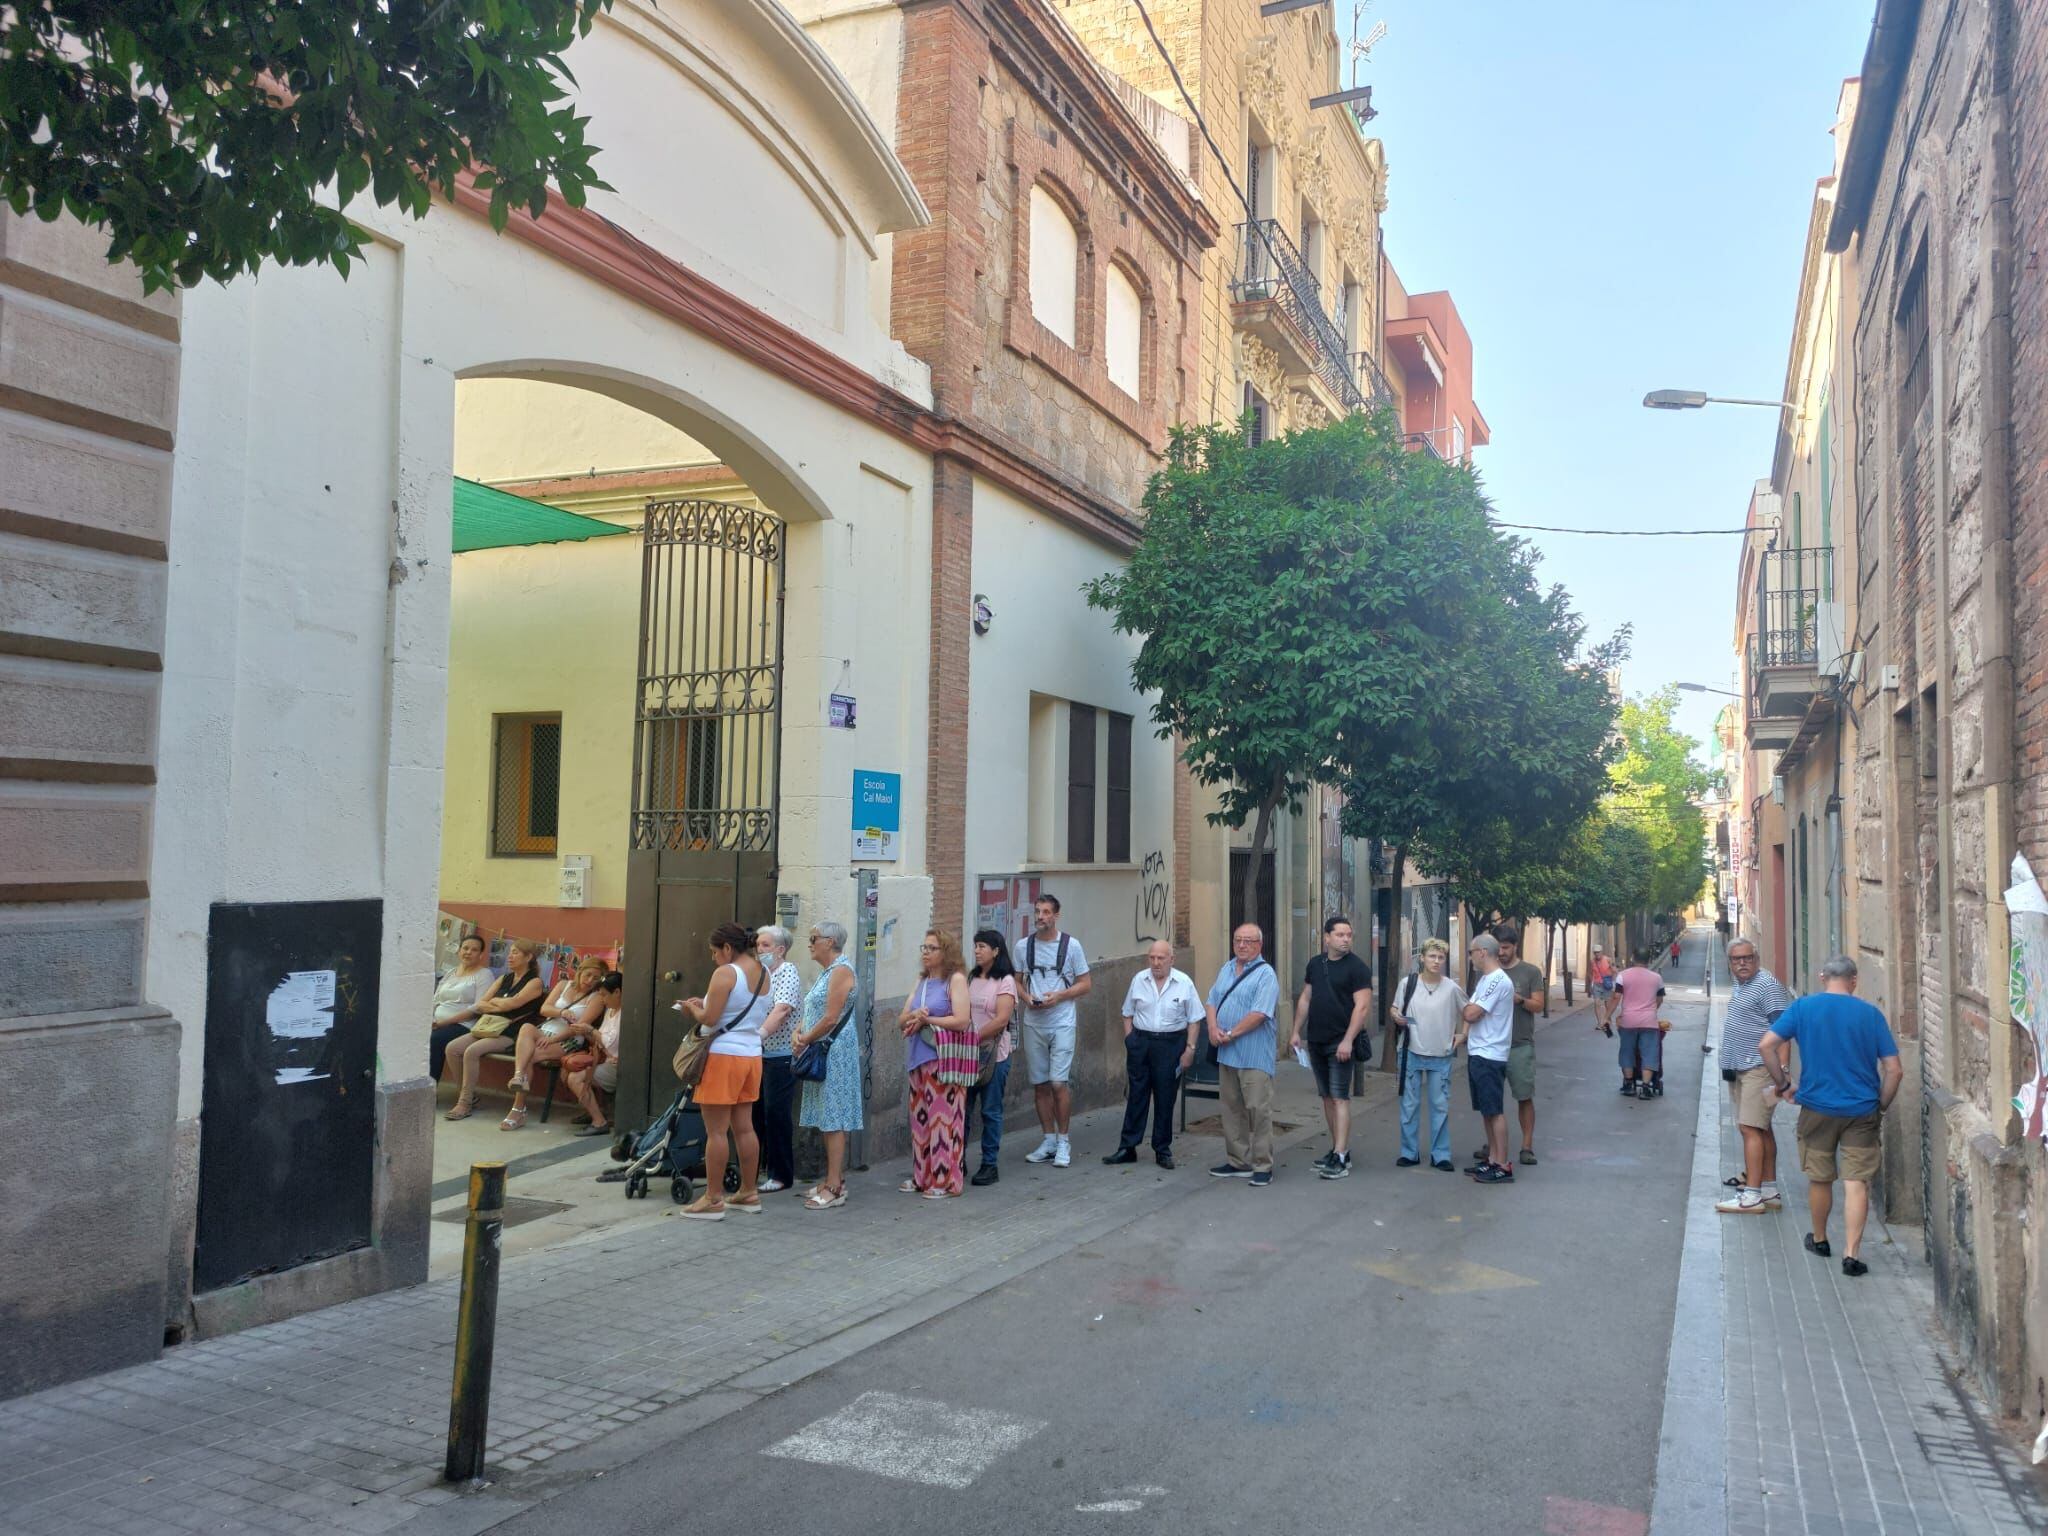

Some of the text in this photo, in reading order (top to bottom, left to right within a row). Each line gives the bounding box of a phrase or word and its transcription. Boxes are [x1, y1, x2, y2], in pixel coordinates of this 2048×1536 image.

[863, 779, 886, 791] Escola
[863, 792, 893, 805] Cal Maiol
[1141, 850, 1165, 879] VOTA
[1143, 880, 1169, 930] VOX
